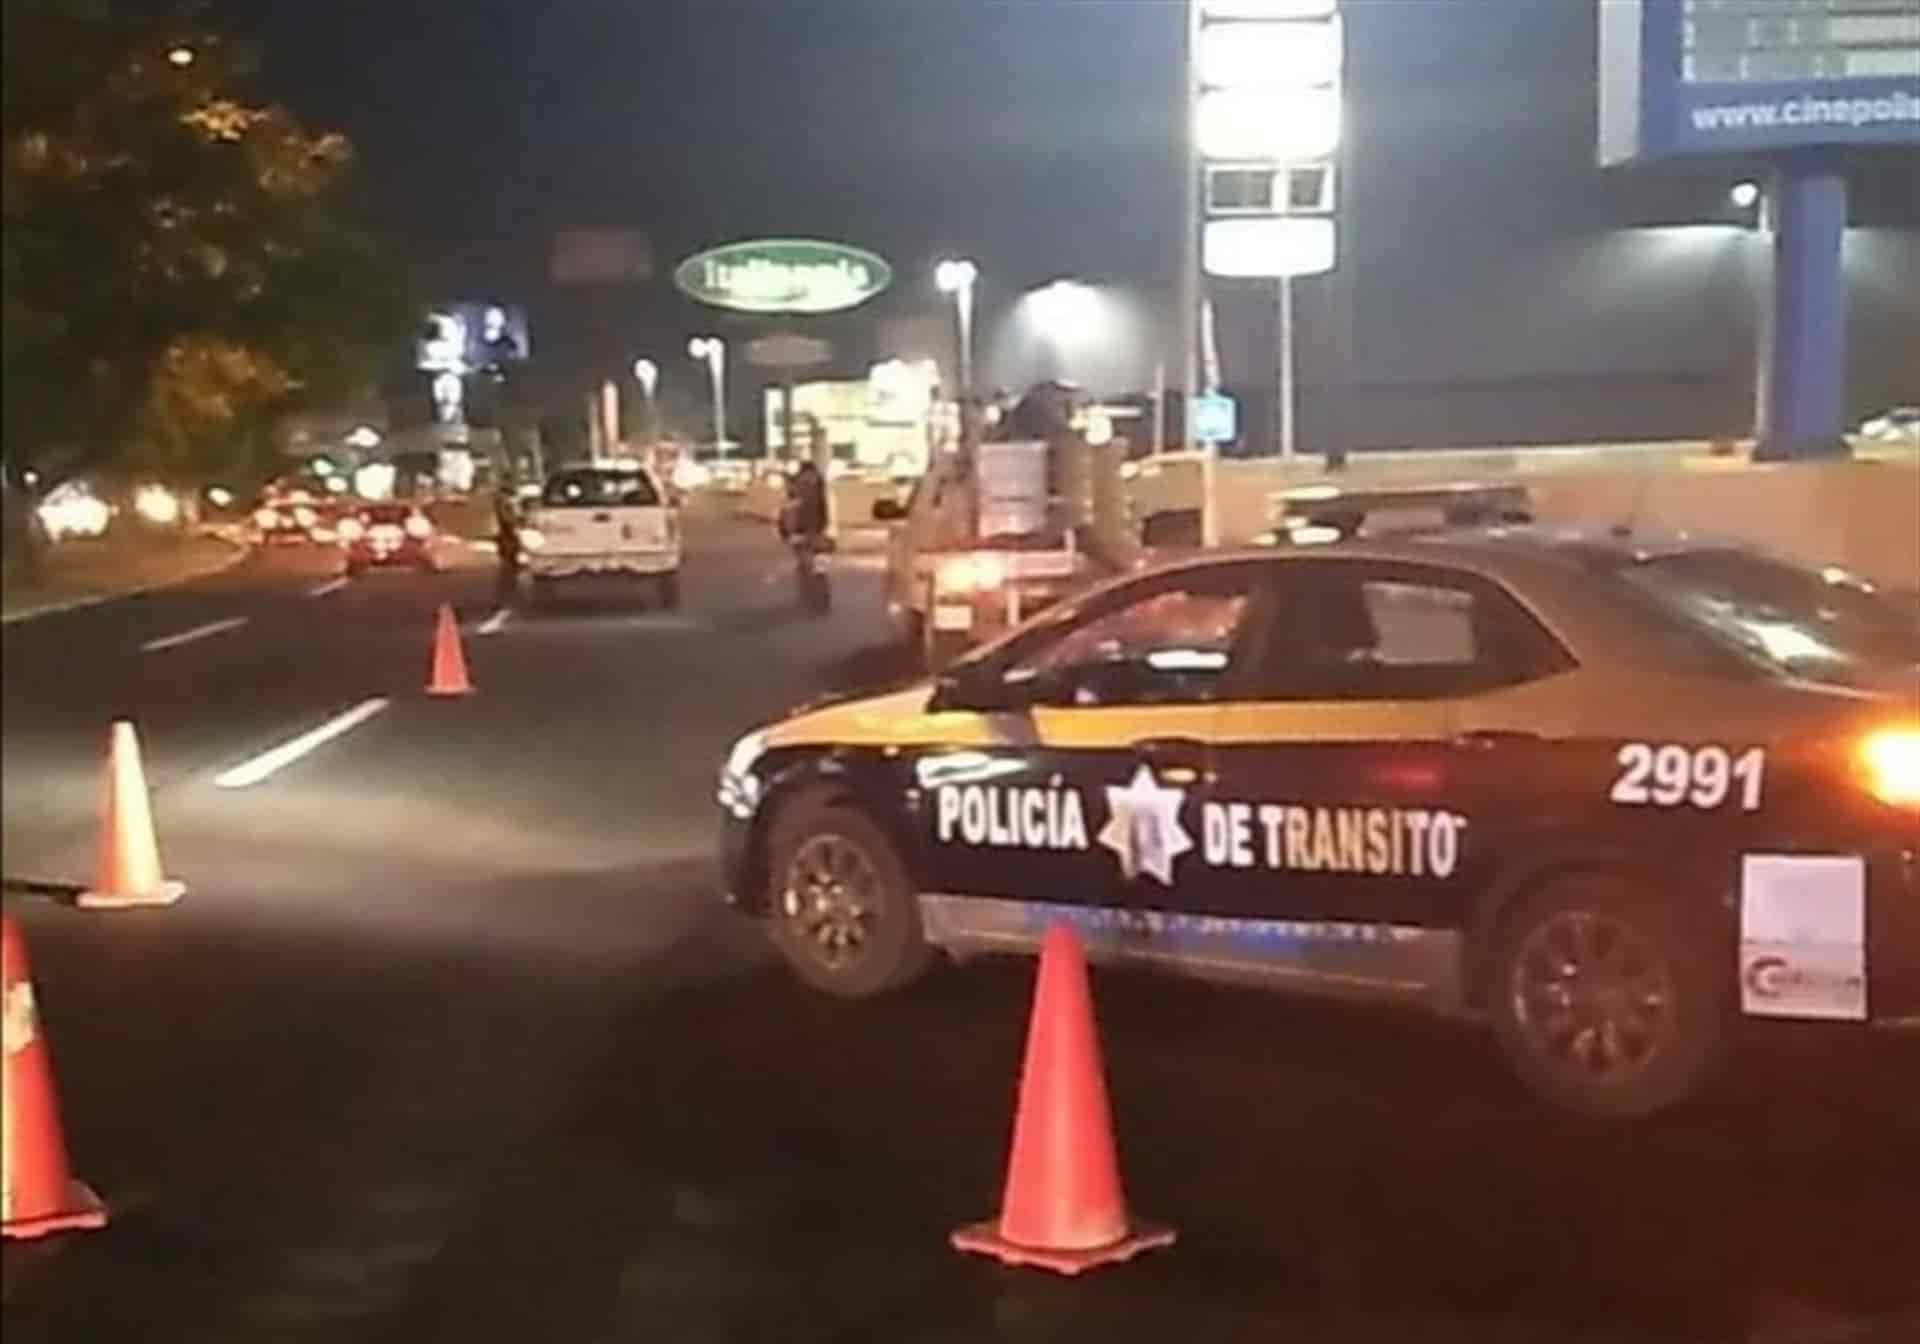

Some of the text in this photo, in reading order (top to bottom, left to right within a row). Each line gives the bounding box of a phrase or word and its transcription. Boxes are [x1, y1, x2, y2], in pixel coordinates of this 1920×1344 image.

[1610, 743, 1765, 811] 2991
[937, 773, 1458, 878] POLICÍA DE TRANSITO
